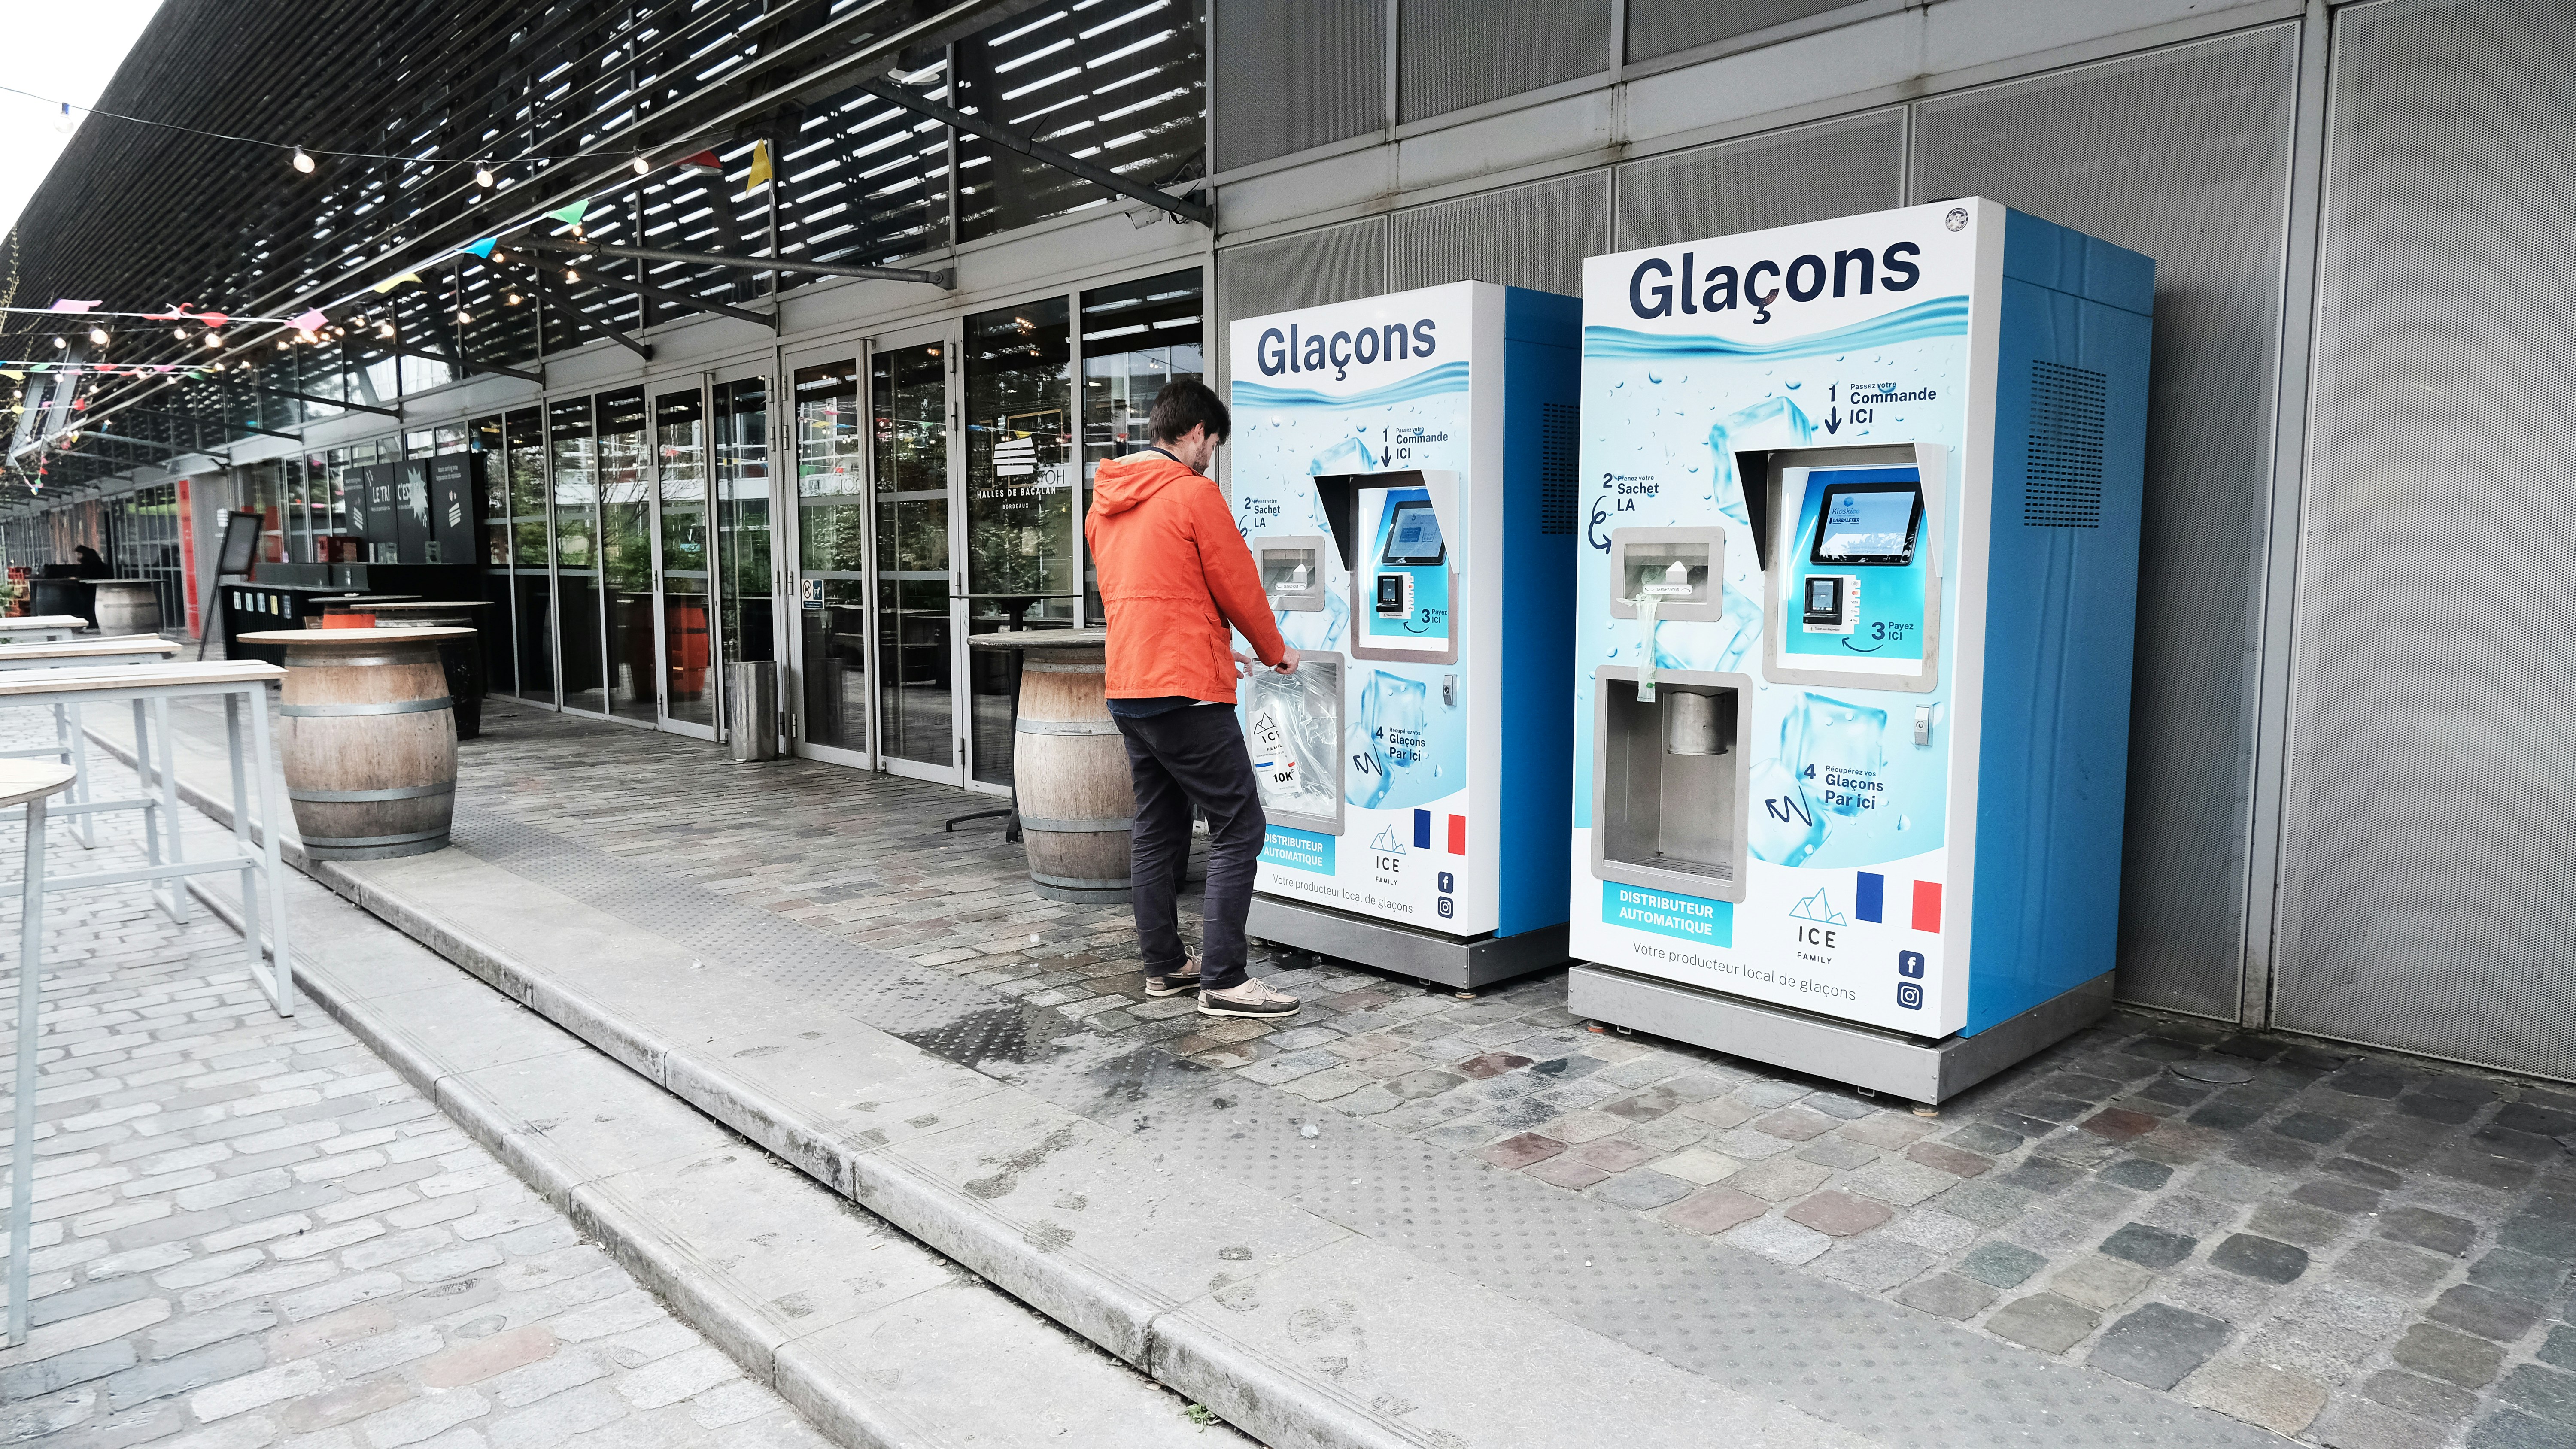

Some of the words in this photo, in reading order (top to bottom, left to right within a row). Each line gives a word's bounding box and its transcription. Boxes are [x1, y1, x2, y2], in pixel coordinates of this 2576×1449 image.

[1629, 241, 1920, 324] Glaçons
[1258, 318, 1436, 381] Glaçons
[1829, 385, 1836, 402] 1
[1850, 387, 1936, 404] Commande
[1850, 409, 1873, 424] ICI
[1383, 428, 1387, 442] 1
[1396, 431, 1448, 444] Commande
[1396, 448, 1410, 459] ICI
[1603, 473, 1613, 488] 2
[1617, 482, 1659, 494] Sachet
[373, 487, 380, 503] LE
[380, 485, 390, 502] TRI
[977, 489, 1004, 499] HALLES
[1008, 488, 1017, 497] DE
[1021, 487, 1056, 496] BACALAN
[1245, 497, 1251, 509] 2
[1254, 505, 1280, 514] Sachet
[1617, 498, 1635, 511] LA
[1254, 517, 1266, 527] LA
[1422, 609, 1430, 623] 3
[1871, 622, 1885, 640] 3
[1889, 622, 1914, 631] Payez
[1889, 631, 1902, 640] ICI
[1376, 726, 1384, 739] 4
[1390, 734, 1425, 748] Glaçons
[1390, 747, 1406, 759] Par
[1410, 749, 1421, 761] ici
[1804, 764, 1816, 779] 4
[1826, 765, 1862, 775] Récupérez
[1826, 774, 1883, 791] Glaçons
[1825, 790, 1853, 807] Par
[1857, 794, 1875, 809] ici
[1264, 832, 1323, 852] DISTRIBUTEUR
[1264, 846, 1323, 866] AUTOMATIQUE
[1376, 856, 1400, 873] ICE
[1376, 876, 1397, 885] FAMILY
[1273, 873, 1294, 887] Votre
[1296, 879, 1340, 897] producteur
[1343, 888, 1362, 902] local
[1365, 894, 1376, 905] de
[1378, 898, 1413, 913] glaçons
[1620, 890, 1713, 919] DISTRIBUTEUR
[1619, 906, 1712, 936] AUTOMATIQUE
[1798, 925, 1835, 949] ICE
[1797, 952, 1832, 964] FAMILY
[1633, 941, 1665, 959] Votre
[1669, 950, 1740, 975] producteur
[1744, 964, 1775, 984] local
[1779, 973, 1795, 988] de
[1800, 979, 1856, 1001] glaçons
